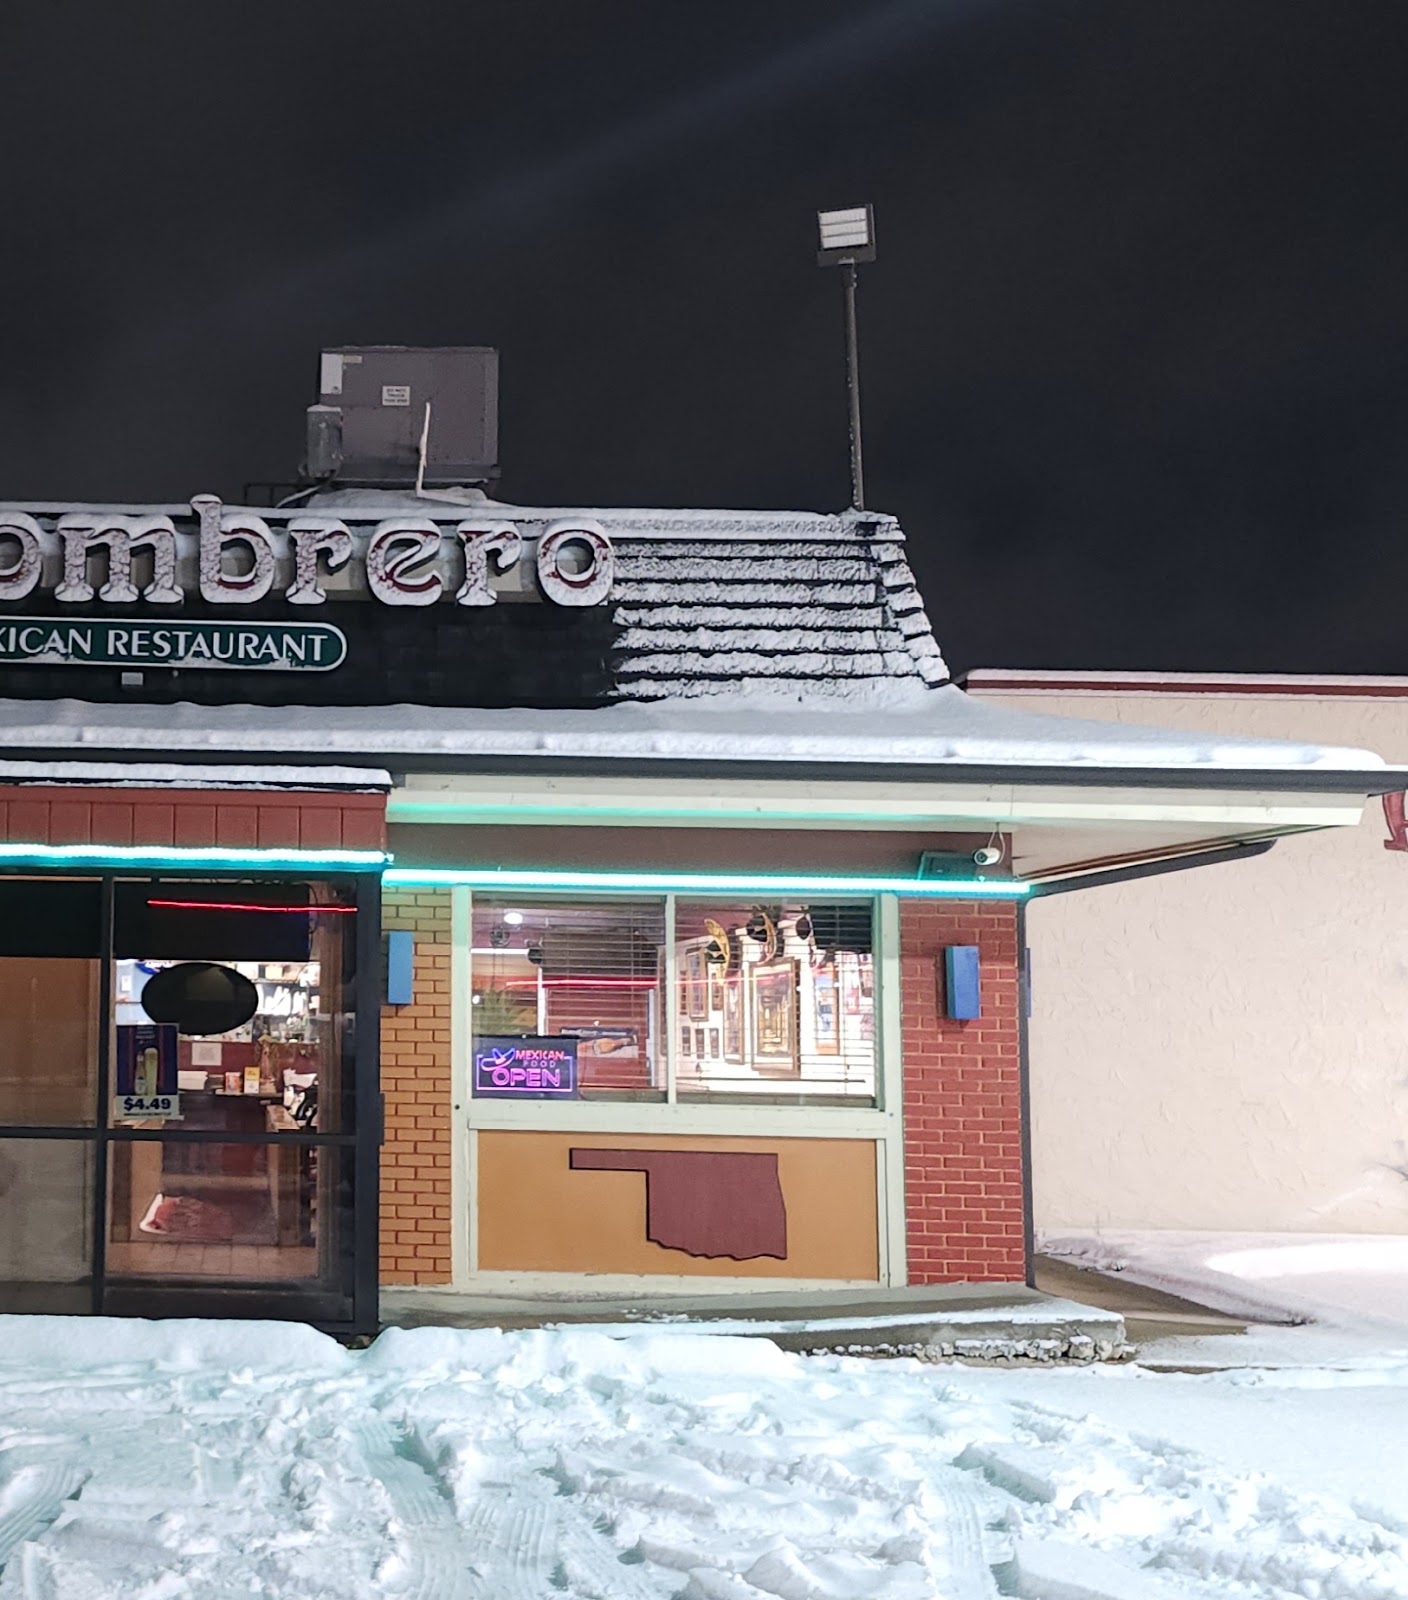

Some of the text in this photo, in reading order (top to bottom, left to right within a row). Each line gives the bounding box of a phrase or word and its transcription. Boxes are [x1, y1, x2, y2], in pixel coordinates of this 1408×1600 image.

[106, 628, 329, 662] RESTAURANT
[515, 1049, 565, 1061] MEXICAN
[522, 1060, 557, 1068] FOOD
[492, 1068, 561, 1087] OPEN
[123, 1096, 172, 1112] $4.49
